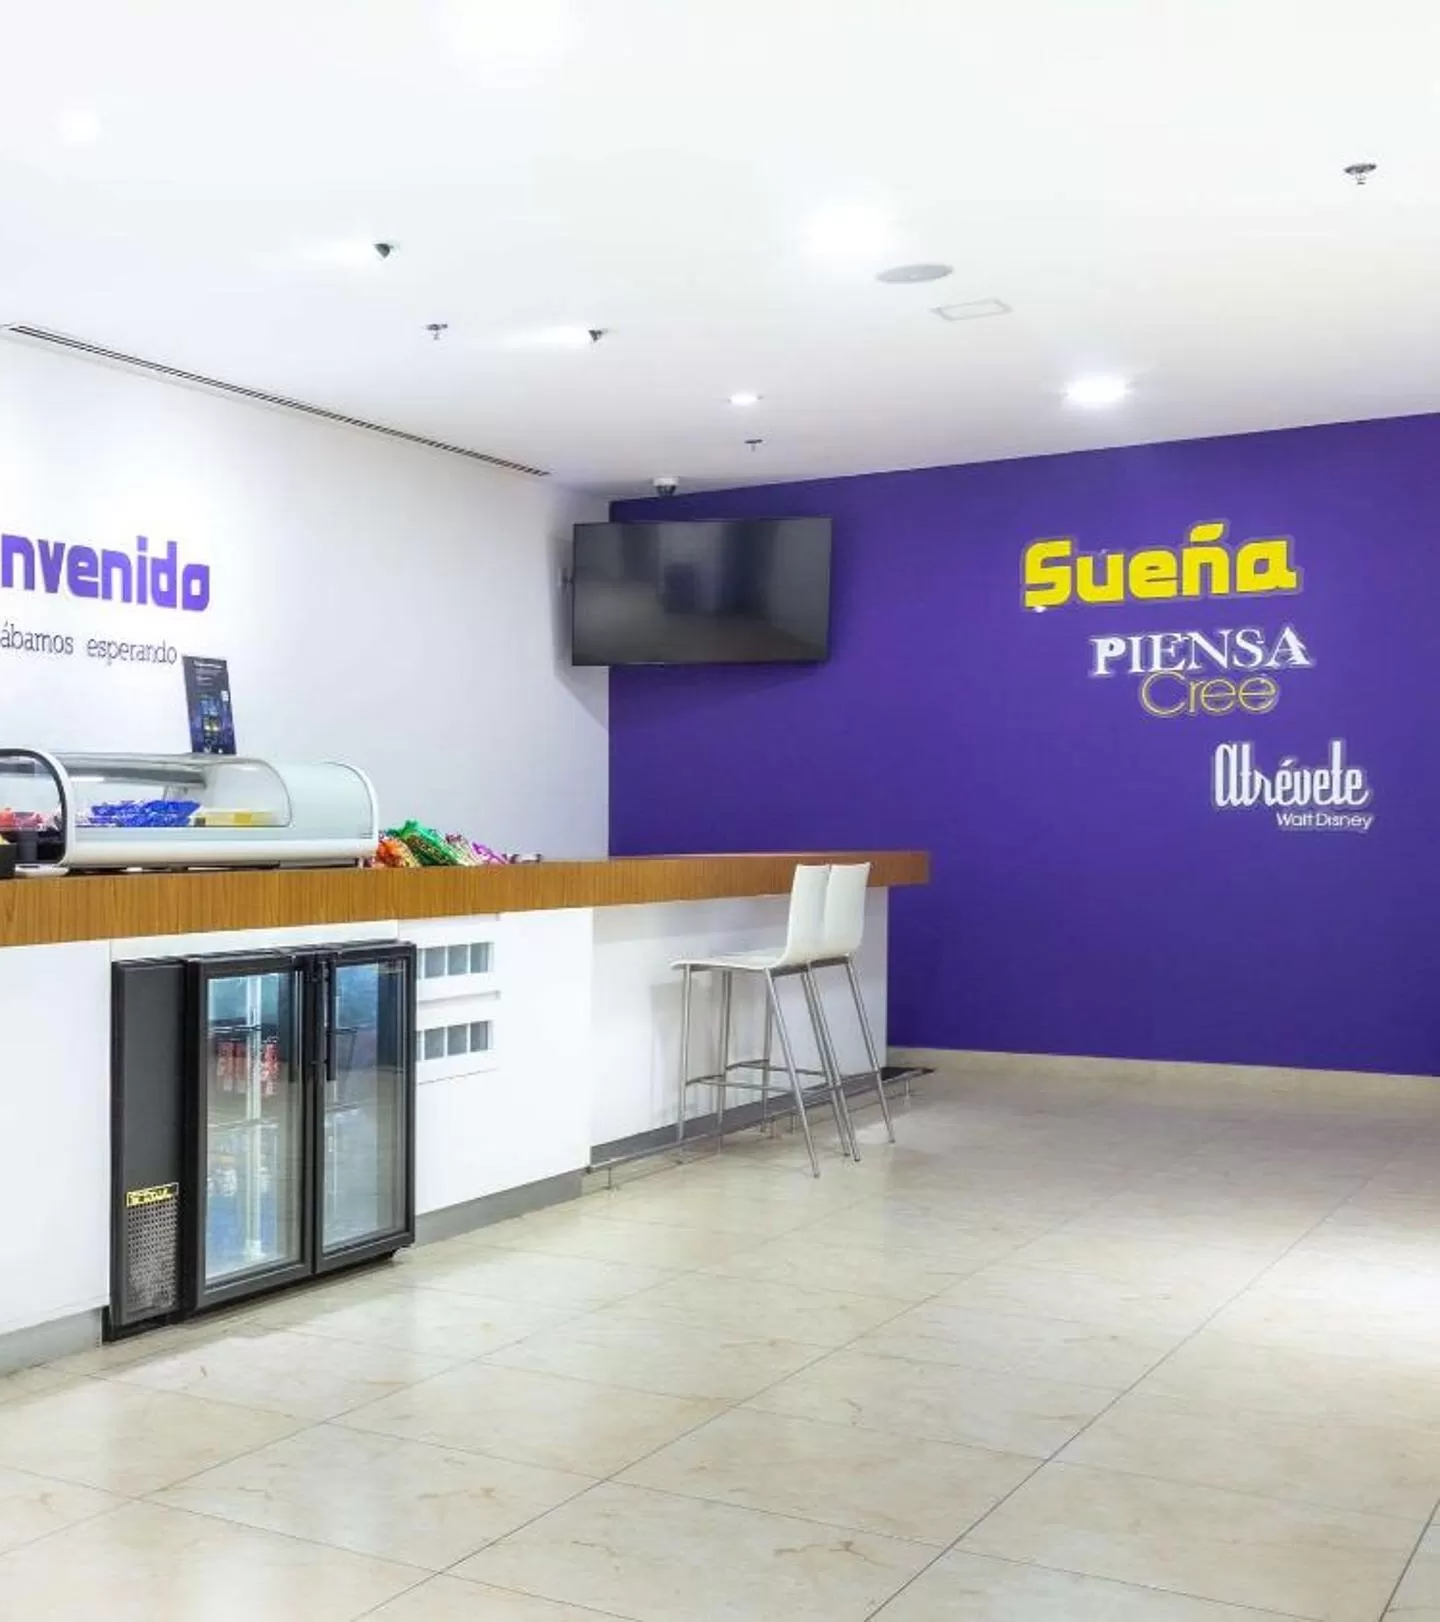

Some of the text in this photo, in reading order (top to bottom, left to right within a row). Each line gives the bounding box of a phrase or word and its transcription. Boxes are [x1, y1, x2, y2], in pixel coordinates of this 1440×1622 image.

[1024, 521, 1298, 608] Sueña
[86, 638, 178, 665] esperando
[1088, 625, 1313, 677] PIENSA
[1140, 668, 1279, 716] Cree
[1214, 740, 1370, 807] Atrévete
[1276, 812, 1373, 831] Walt Disney
